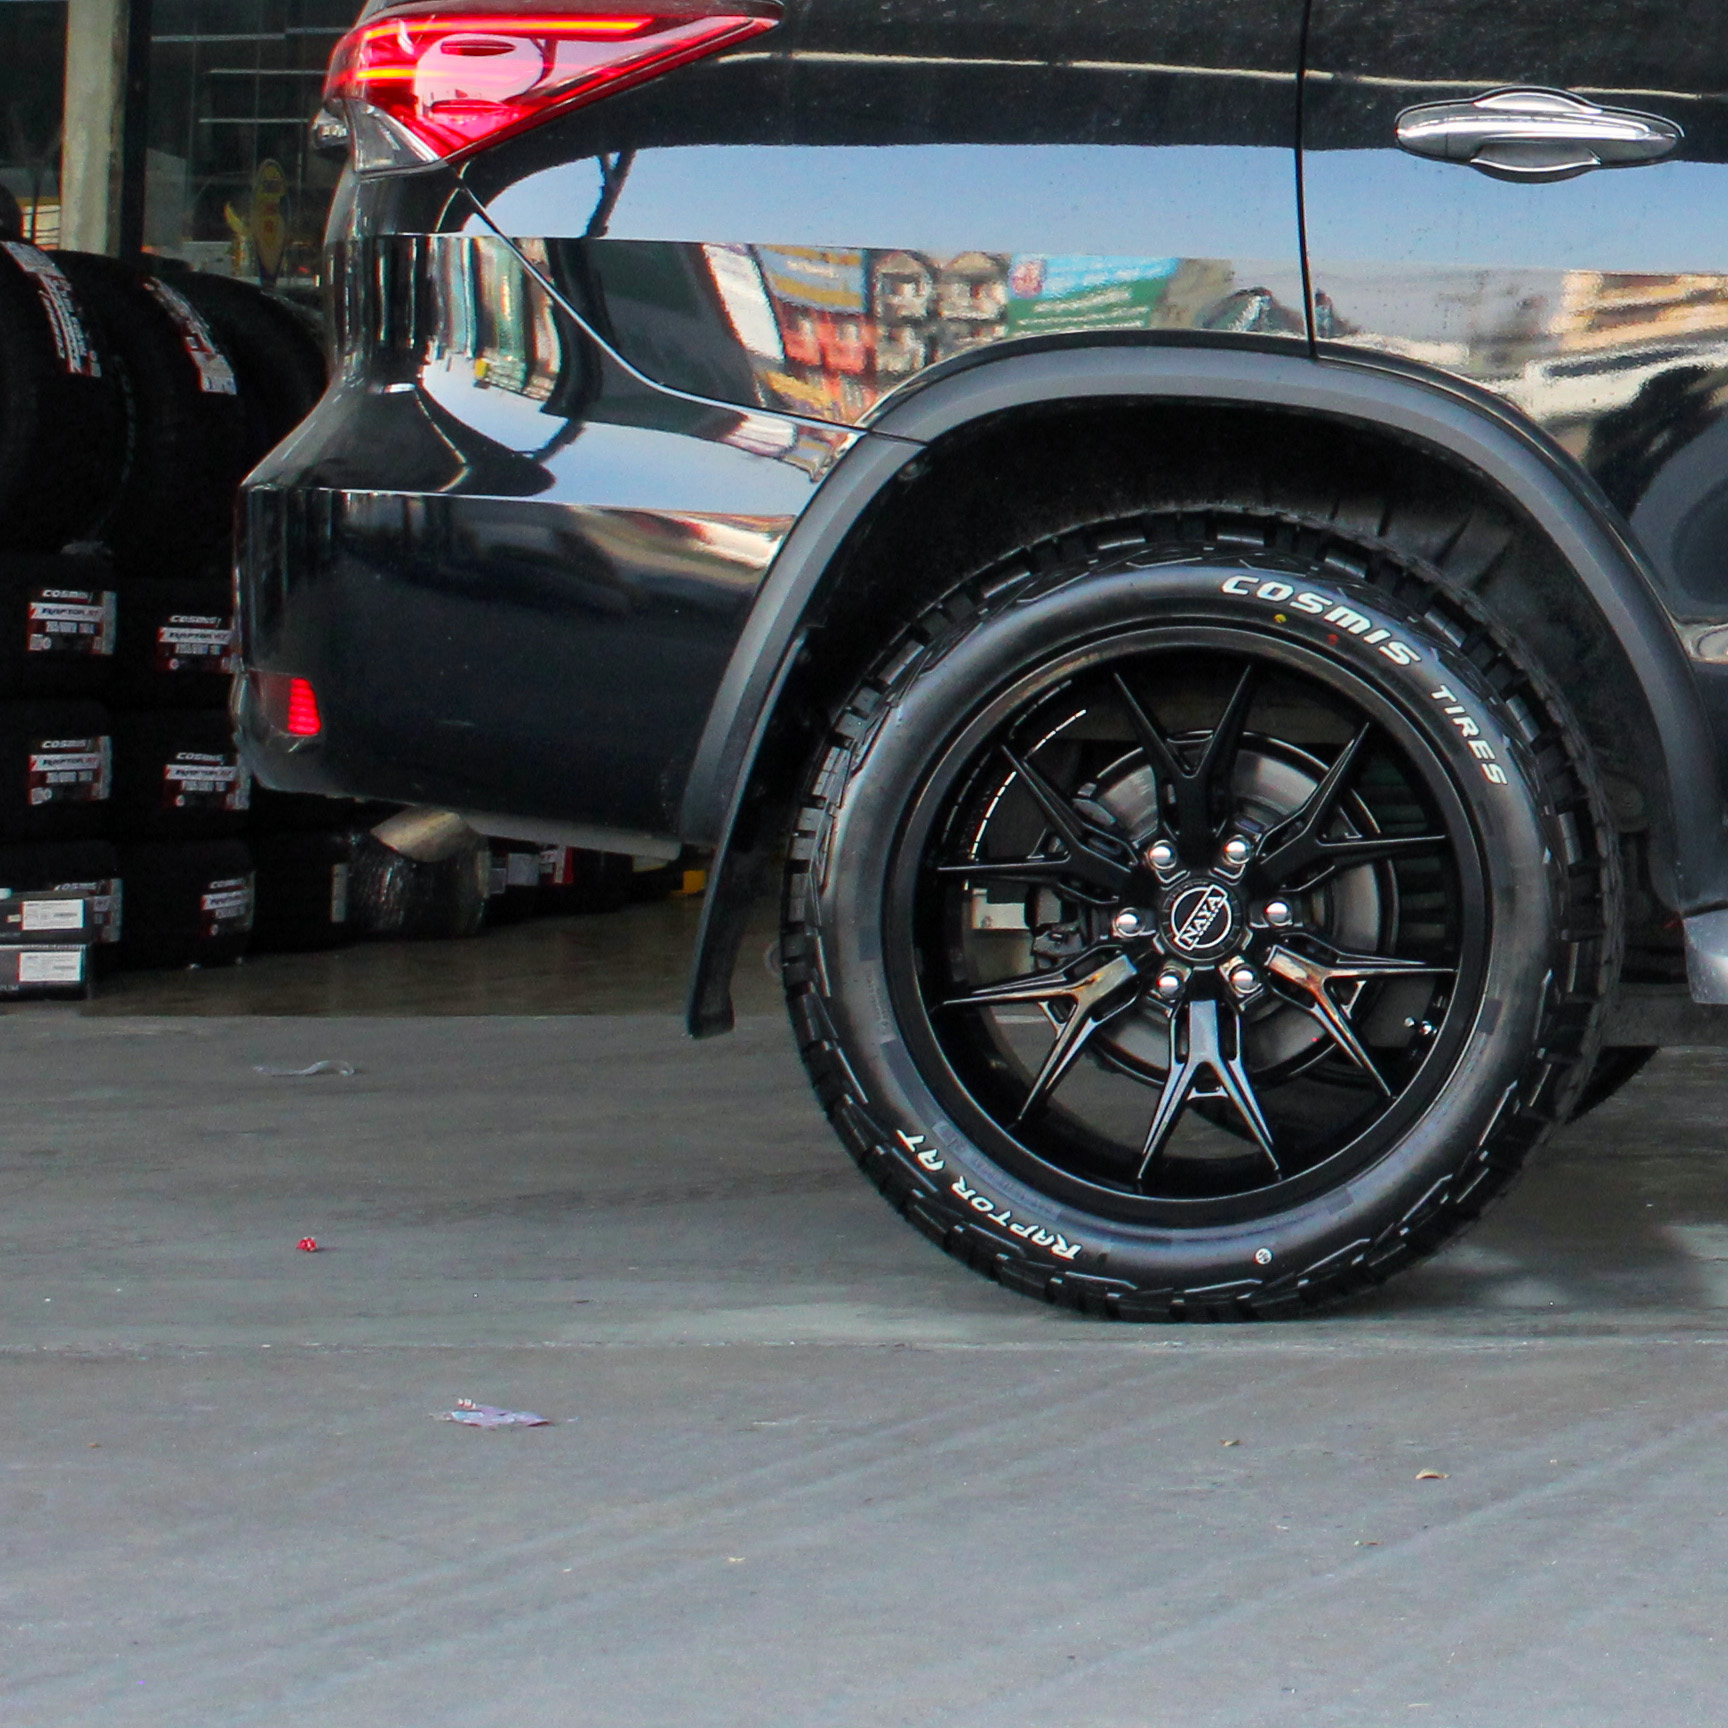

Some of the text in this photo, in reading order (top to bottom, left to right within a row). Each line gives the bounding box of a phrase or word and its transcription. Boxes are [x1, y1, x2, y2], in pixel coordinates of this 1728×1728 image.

[1220, 574, 1510, 786] COSMIS TIRES
[1181, 896, 1222, 945] NAYA
[950, 1175, 1083, 1261] RAPTOR
